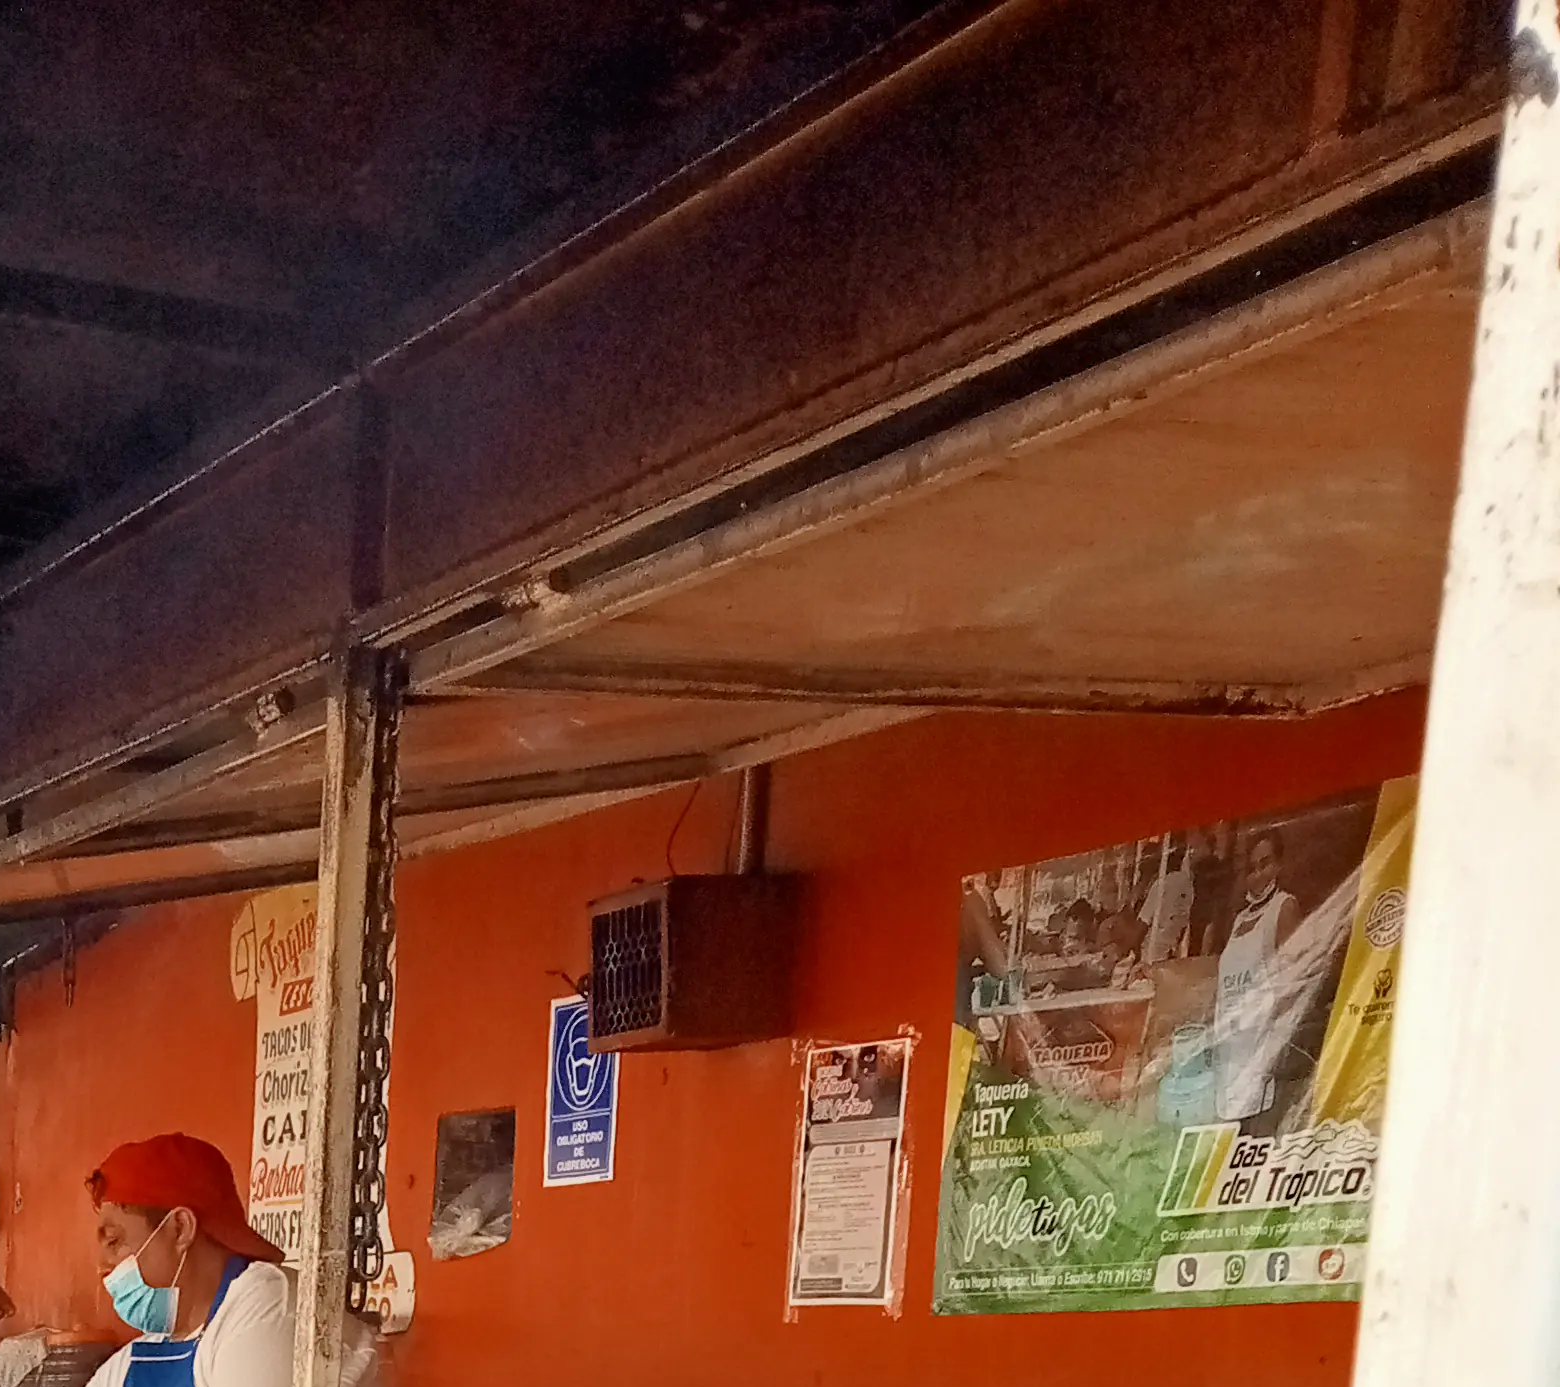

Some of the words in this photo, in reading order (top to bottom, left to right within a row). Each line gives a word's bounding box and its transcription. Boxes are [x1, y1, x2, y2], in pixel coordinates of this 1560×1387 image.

[262, 1024, 298, 1060] TACOS
[262, 1060, 308, 1103] Choriz
[975, 1078, 1029, 1105] Taquería
[572, 1119, 588, 1132] USO
[971, 1106, 1015, 1138] LETY
[556, 1130, 604, 1146] OBLIGATORIO
[573, 1146, 584, 1157] DE
[988, 1136, 1024, 1154] LETICIA
[1229, 1141, 1271, 1170] Gas
[1217, 1169, 1259, 1207] del
